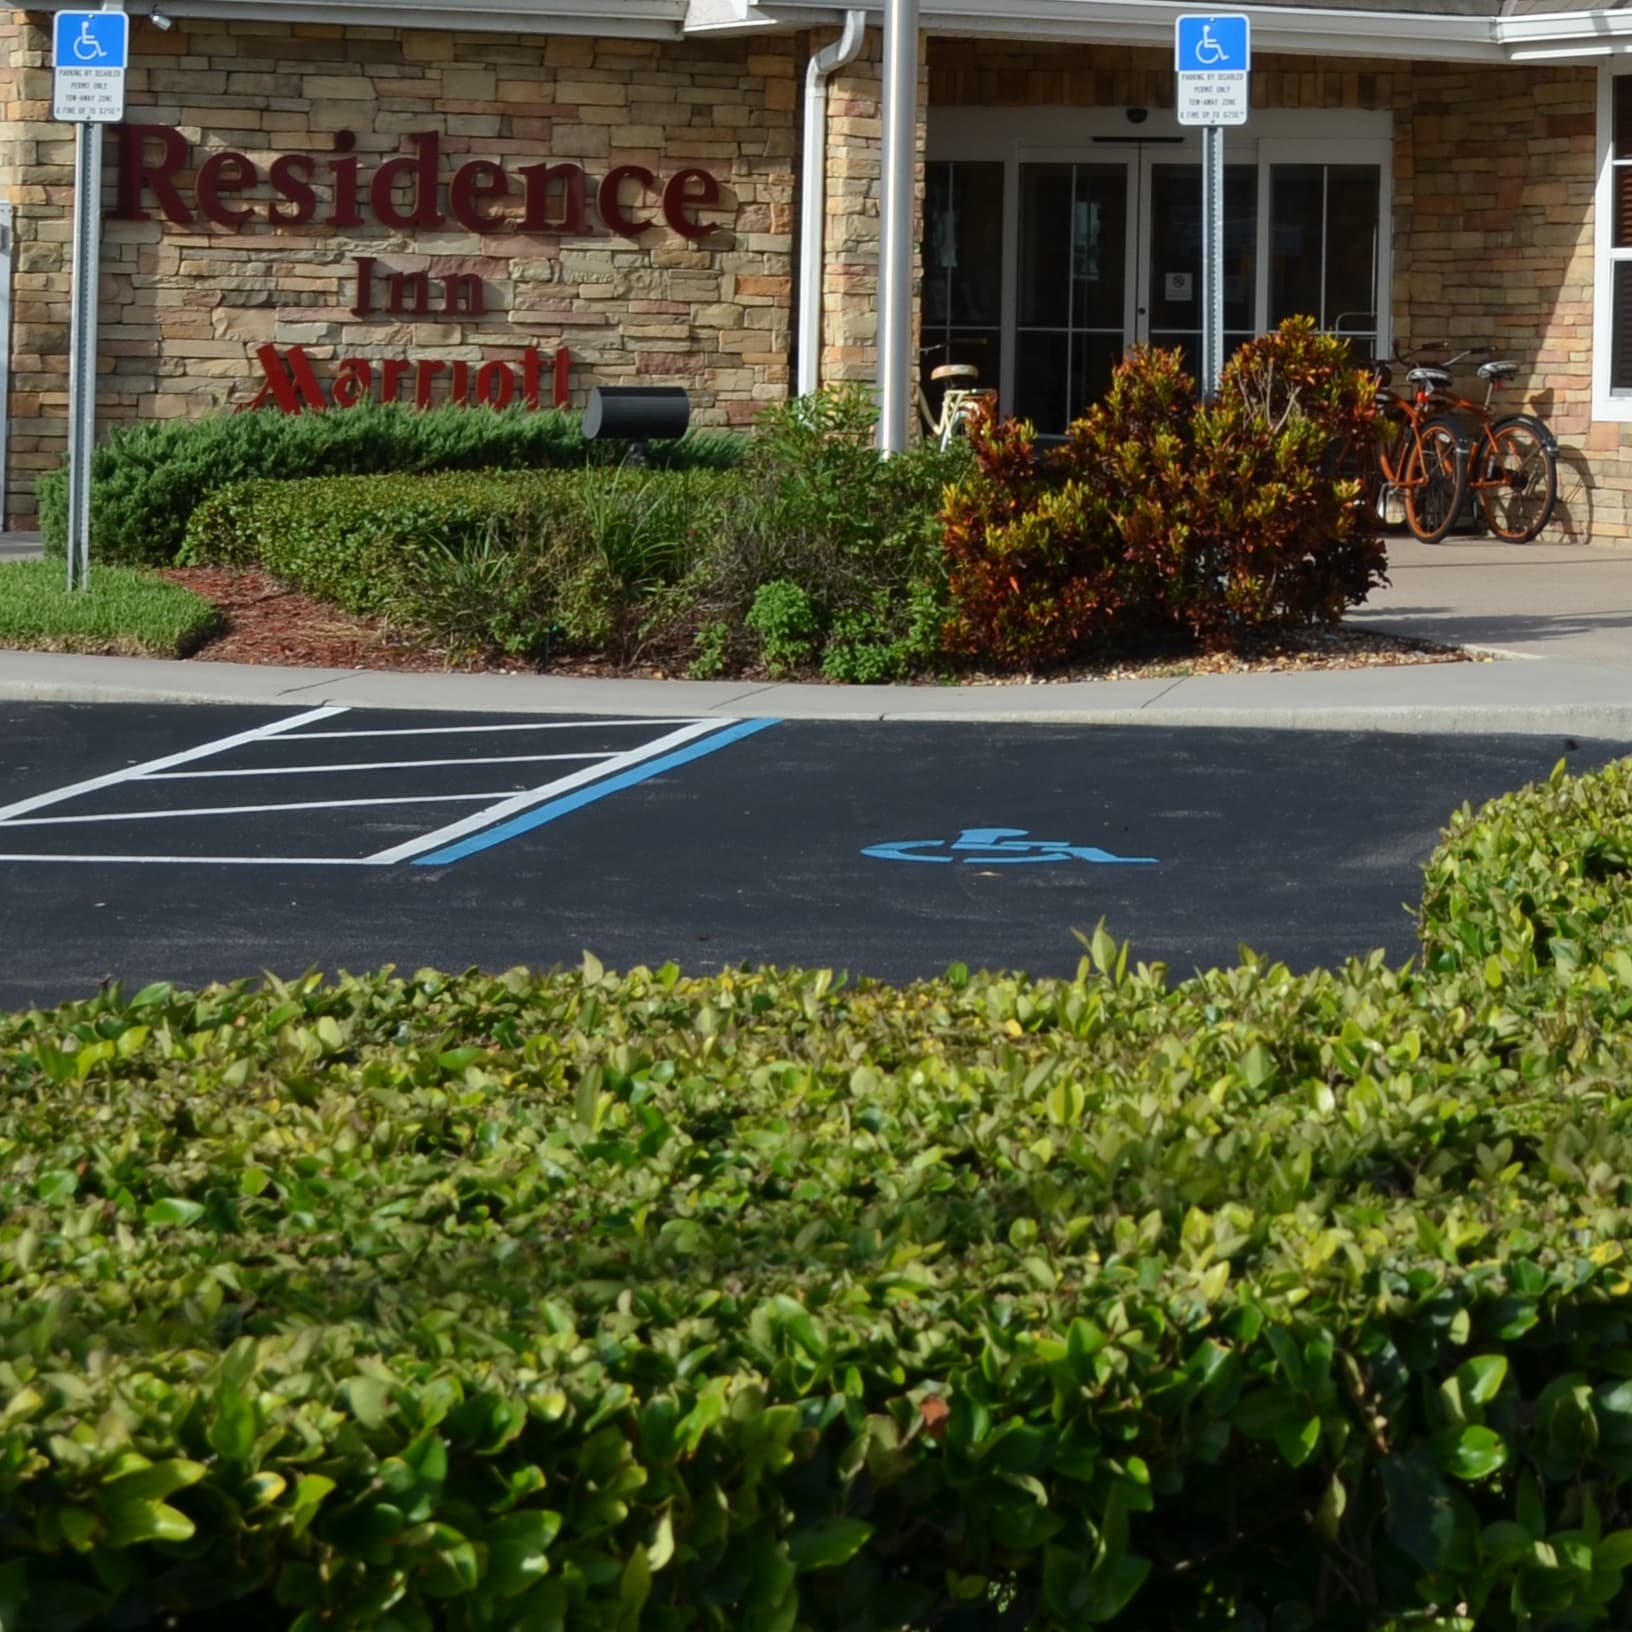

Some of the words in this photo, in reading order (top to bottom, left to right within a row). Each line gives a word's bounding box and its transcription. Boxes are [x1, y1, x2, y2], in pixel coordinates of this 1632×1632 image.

[106, 123, 721, 239] Residence
[350, 256, 489, 317] Inn
[234, 342, 576, 416] Marriott
